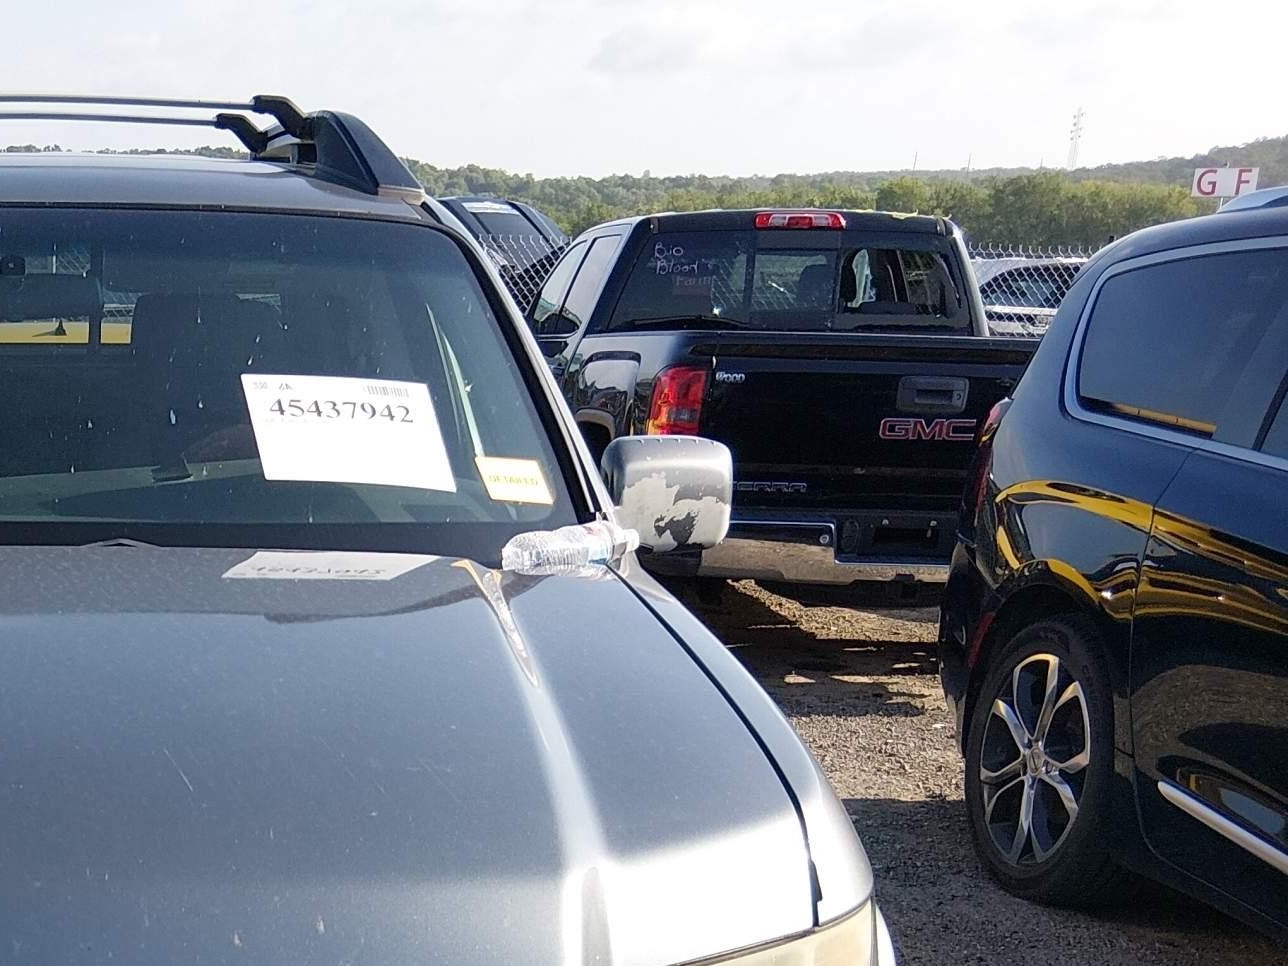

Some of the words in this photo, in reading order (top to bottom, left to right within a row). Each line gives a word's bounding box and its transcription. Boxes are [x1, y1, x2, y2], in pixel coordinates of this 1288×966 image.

[1197, 169, 1218, 196] G
[1234, 168, 1252, 195] F
[654, 241, 684, 258] Bio
[269, 398, 414, 424] 45437942
[879, 418, 977, 440] GMC
